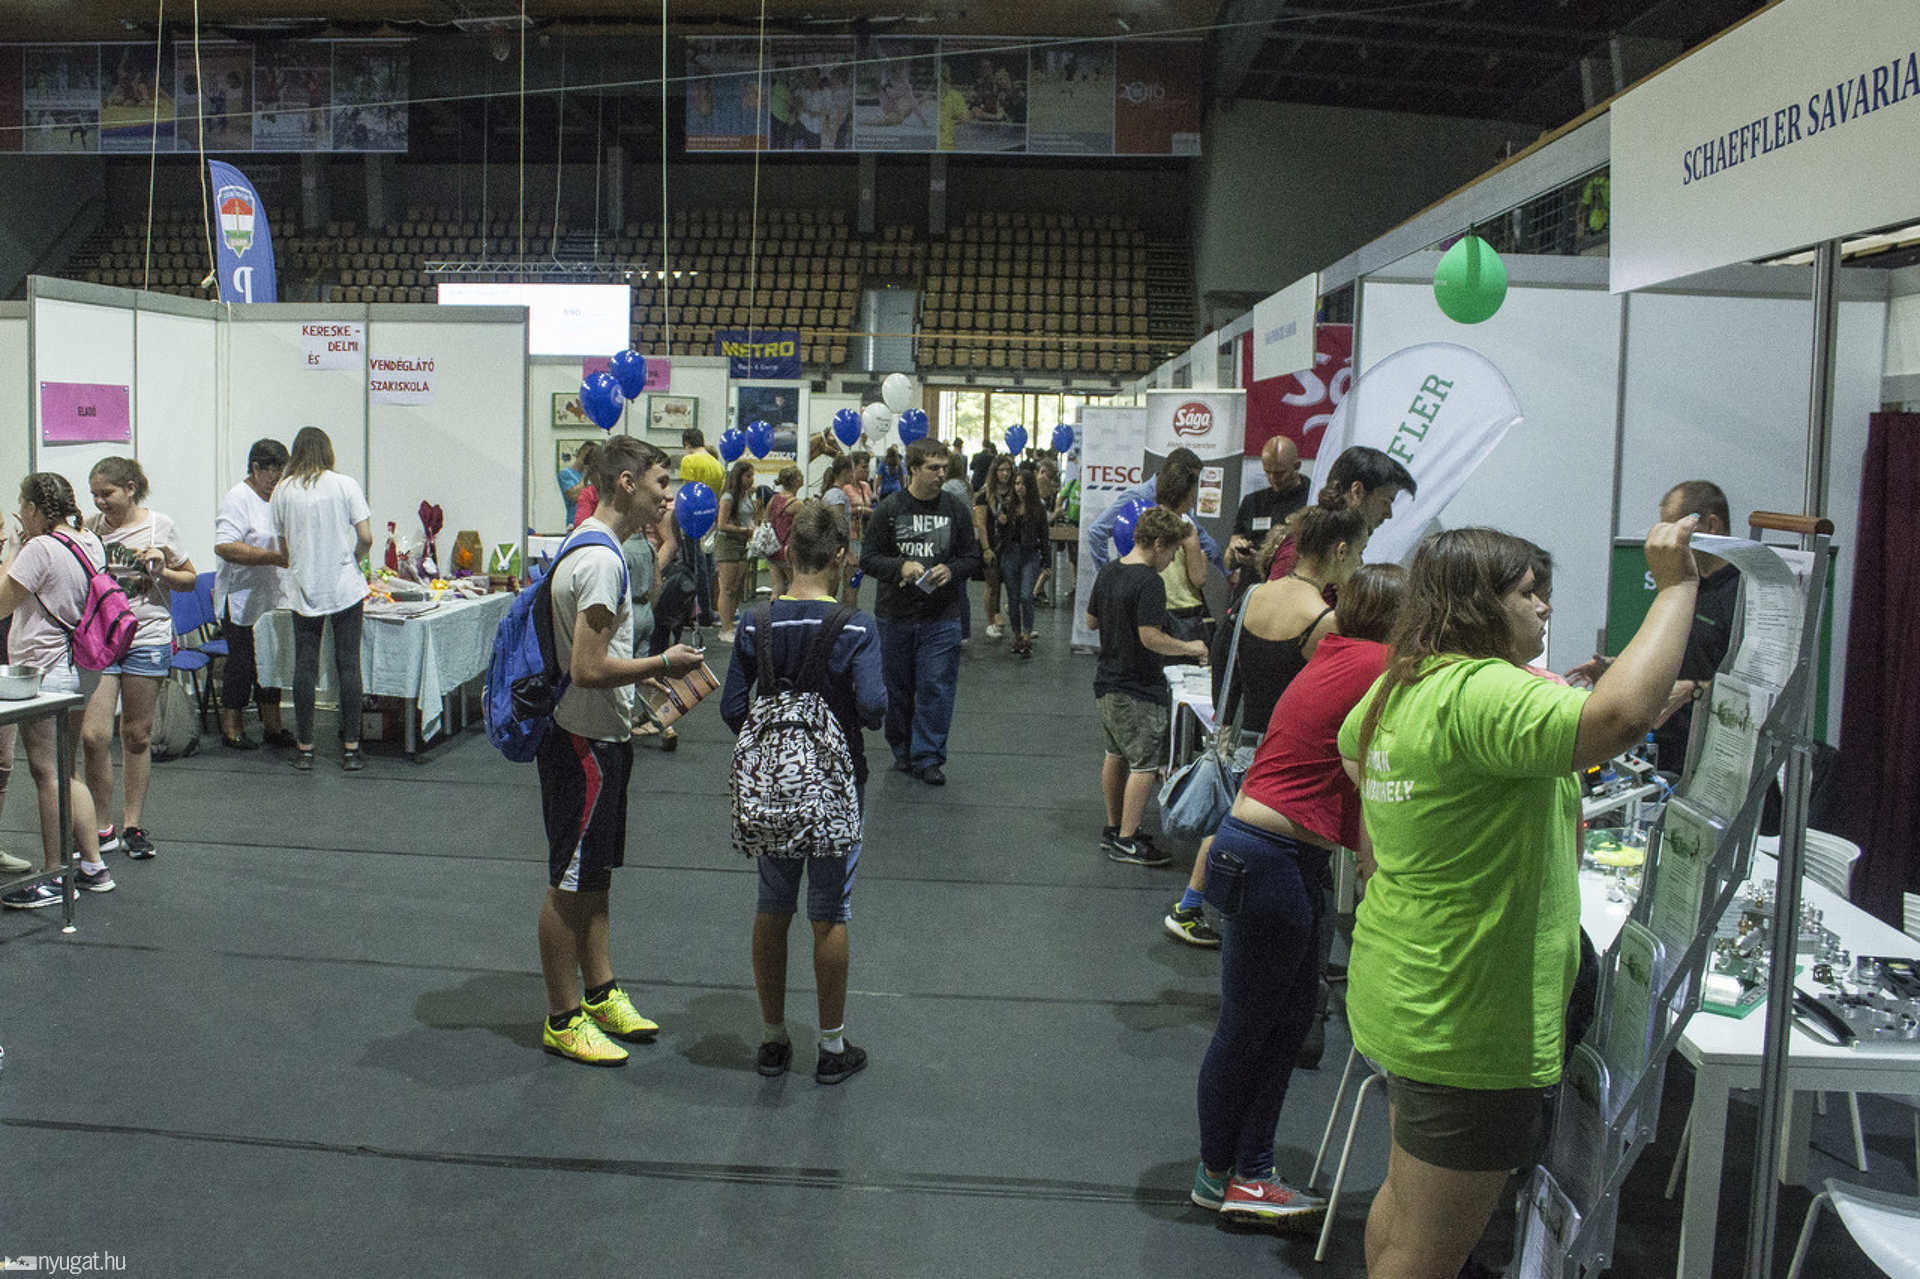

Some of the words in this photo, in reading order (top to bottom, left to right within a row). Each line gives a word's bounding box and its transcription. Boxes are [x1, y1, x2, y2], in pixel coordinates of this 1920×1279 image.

[1682, 103, 1802, 185] SCHAEFFLER
[1806, 51, 1920, 136] SAVARIA
[327, 341, 359, 352] DELMI
[721, 340, 794, 358] METRO
[307, 351, 320, 365] ÉS
[369, 356, 435, 372] VENDÉGLÁTÓ
[369, 380, 430, 392] SZAKISKOLA
[1175, 407, 1211, 429] Sága
[1087, 465, 1144, 484] TESC
[912, 514, 949, 532] NEW
[896, 541, 935, 558] YORK
